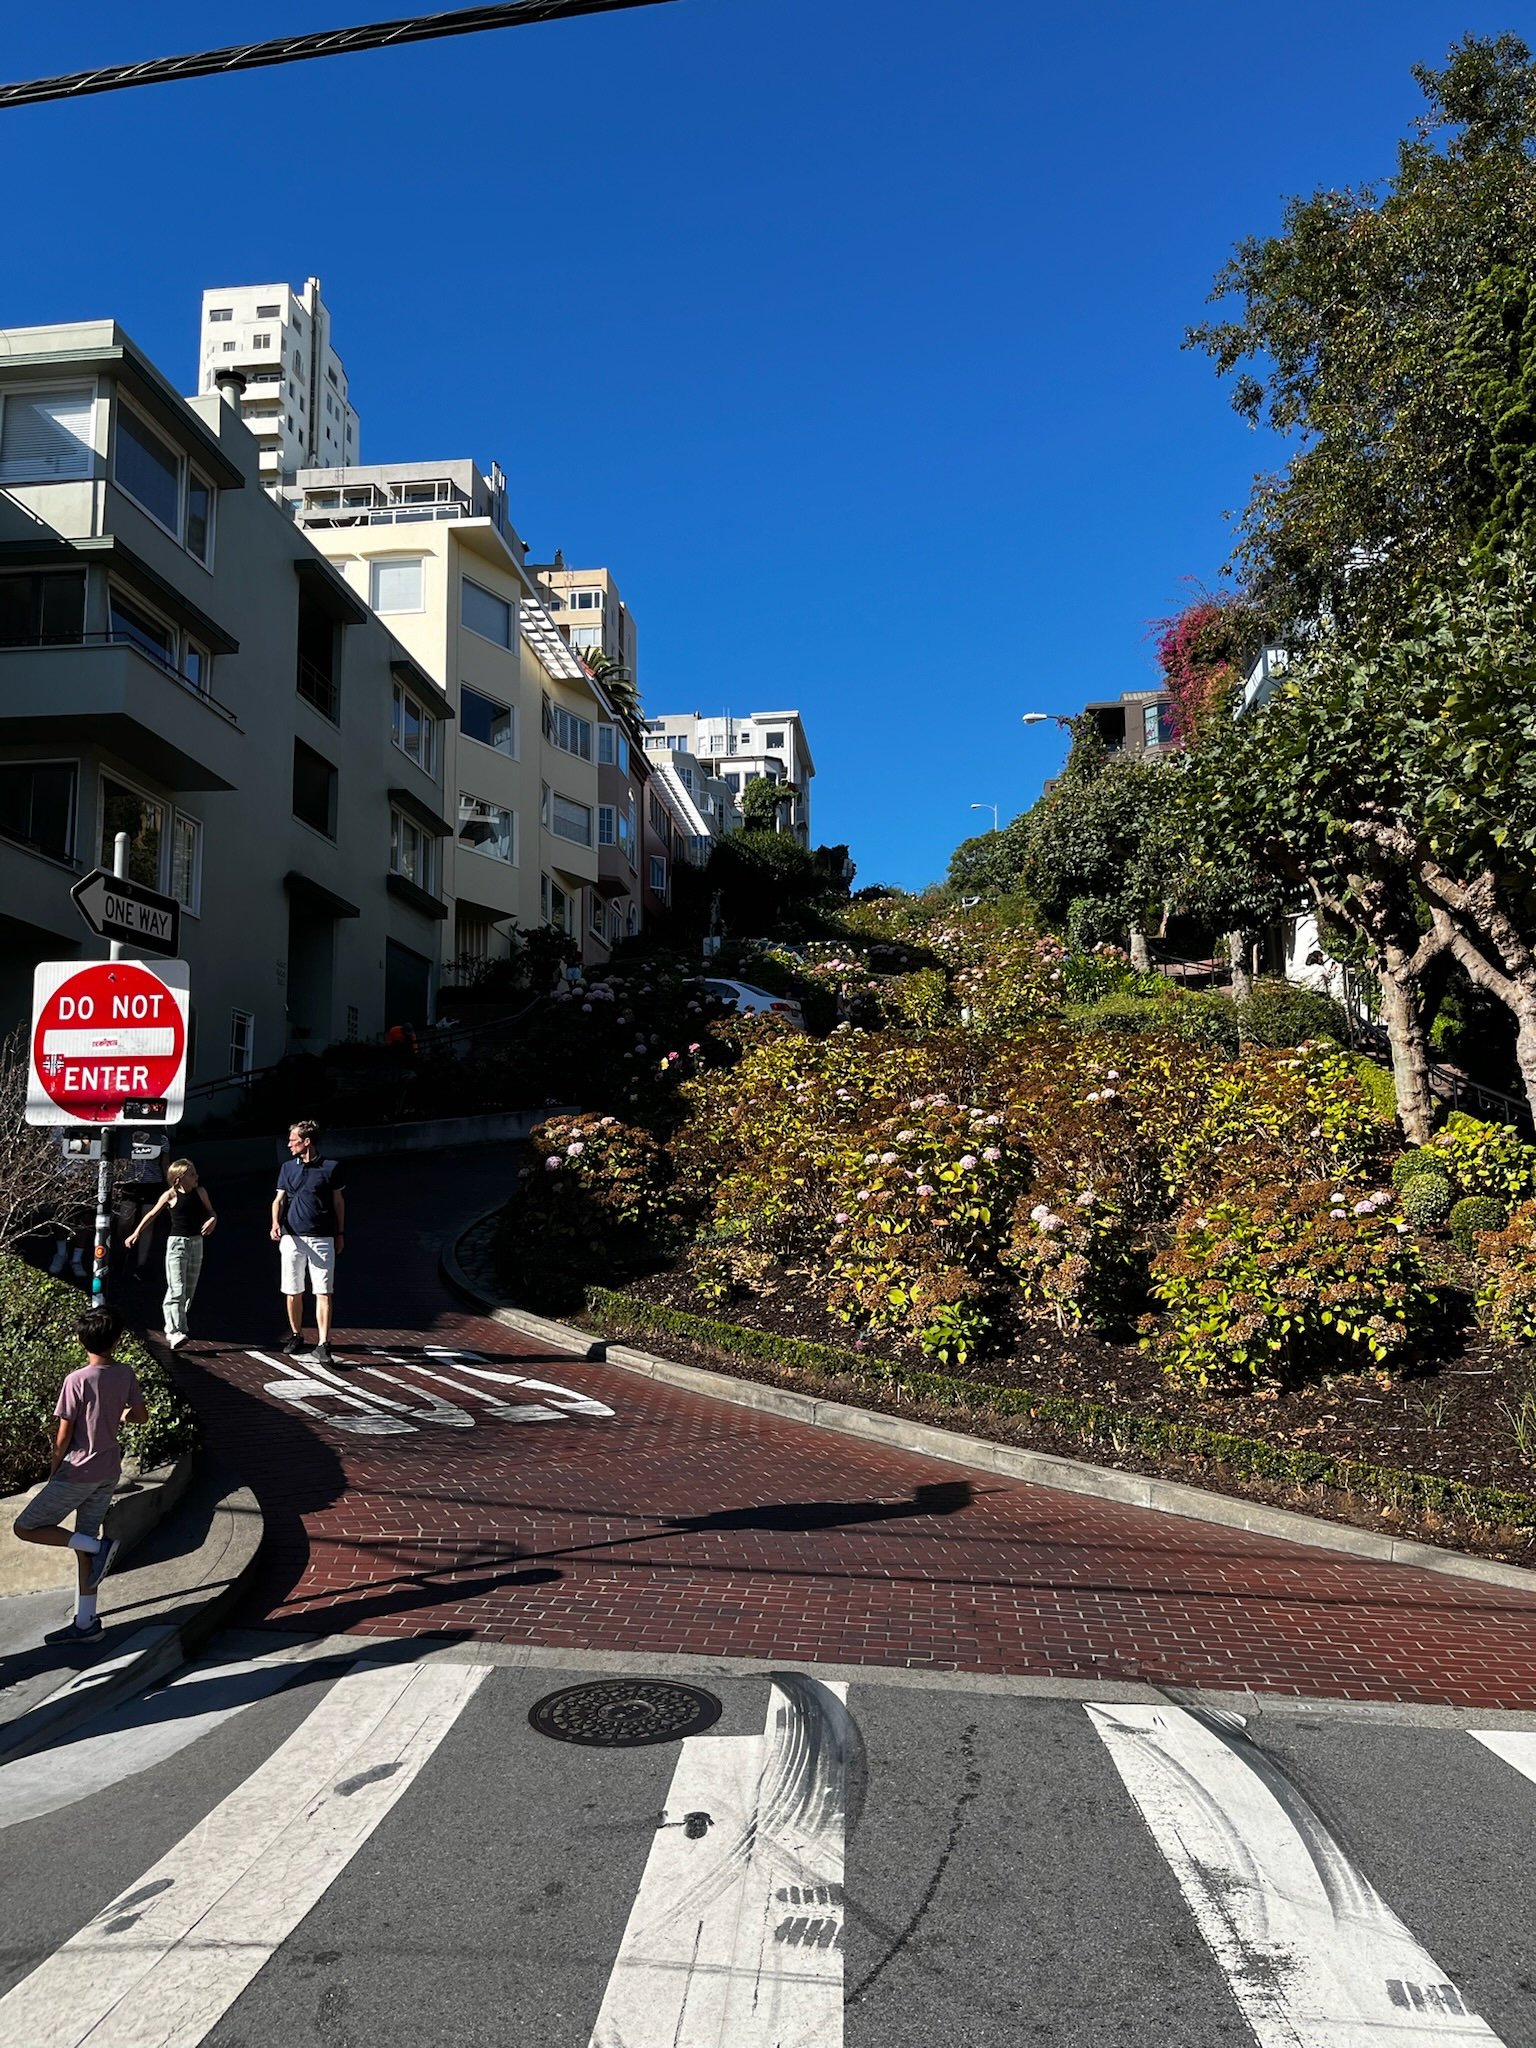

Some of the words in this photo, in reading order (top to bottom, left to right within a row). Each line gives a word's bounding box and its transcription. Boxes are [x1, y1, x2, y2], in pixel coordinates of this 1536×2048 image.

[105, 895, 134, 926] ONE
[139, 906, 168, 937] WAY
[59, 995, 94, 1020] DO
[112, 994, 163, 1019] NOT
[64, 1065, 149, 1092] ENTER
[243, 1345, 616, 1434] STOP
